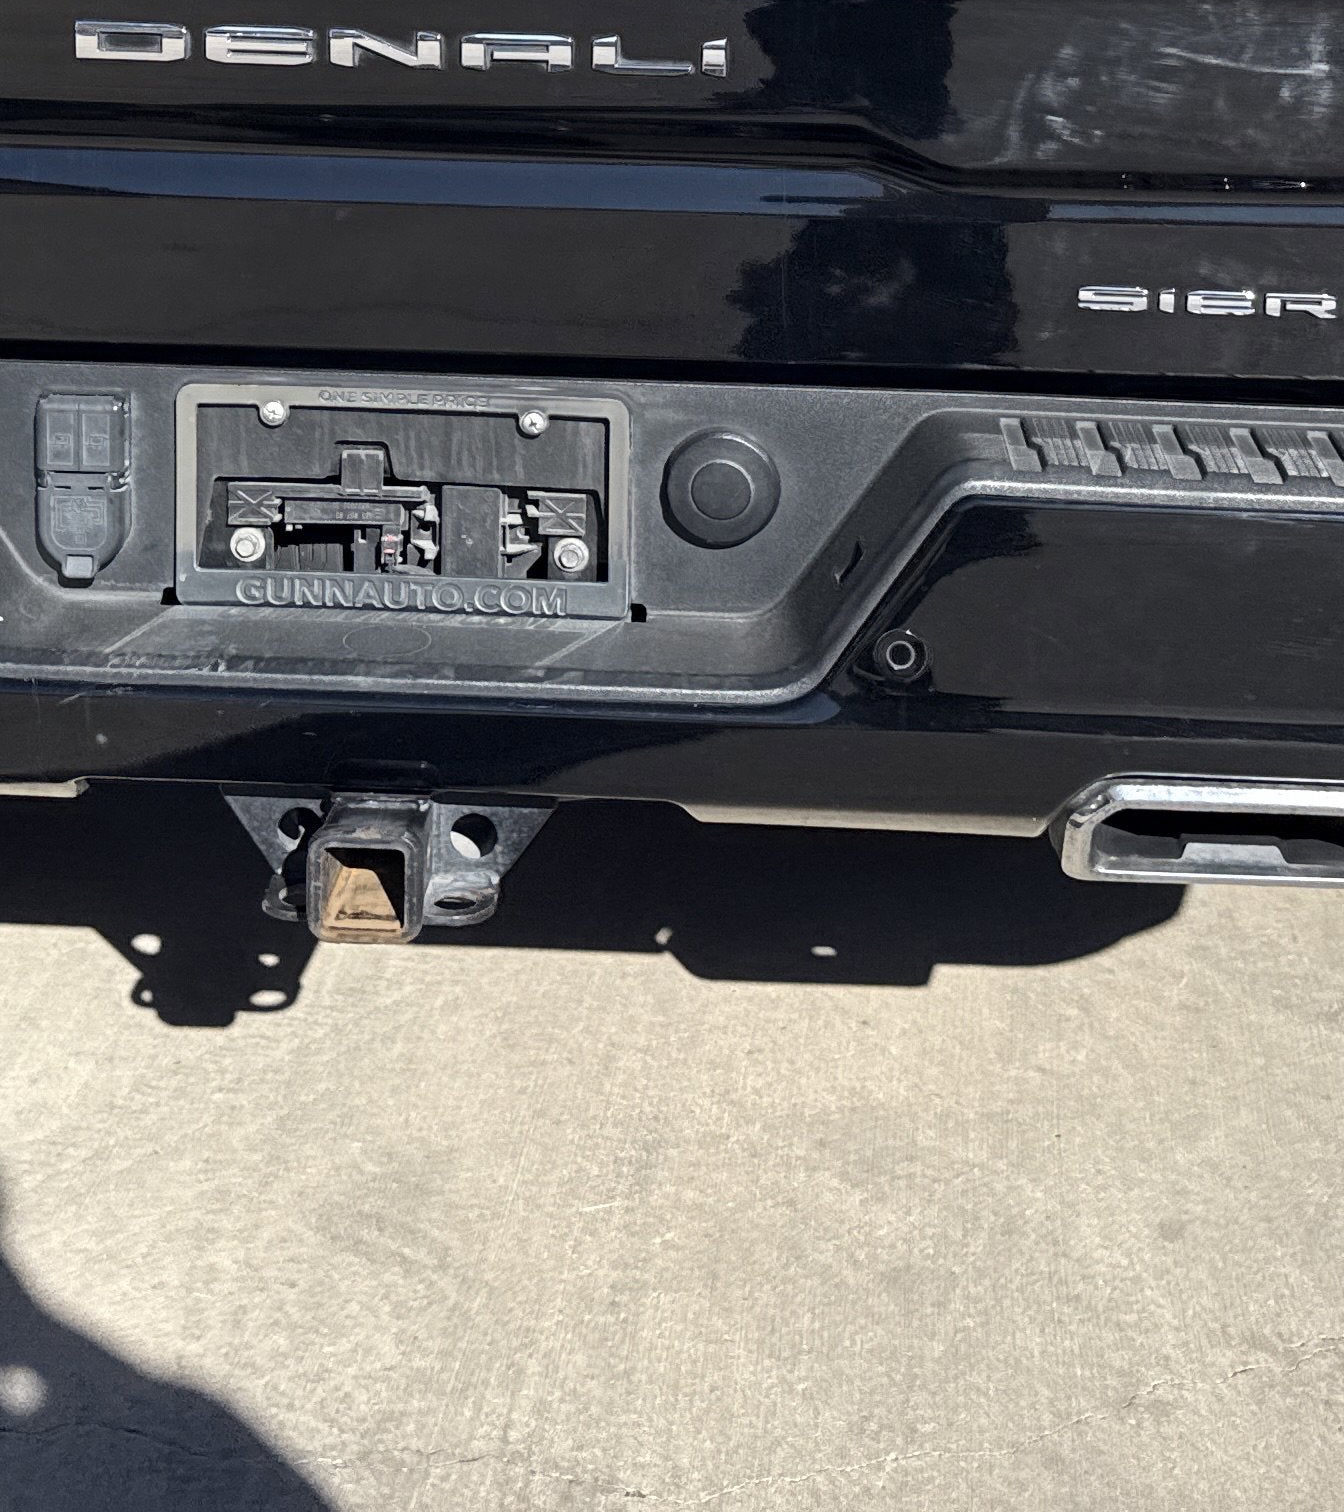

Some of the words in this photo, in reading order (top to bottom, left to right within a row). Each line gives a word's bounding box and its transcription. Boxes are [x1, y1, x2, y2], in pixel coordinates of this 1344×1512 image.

[74, 19, 729, 78] DENALI
[318, 389, 358, 403] ONE
[360, 390, 429, 406] SIMPLE
[431, 393, 491, 409] PRICE
[235, 577, 568, 617] GUNNAUTO.COM
